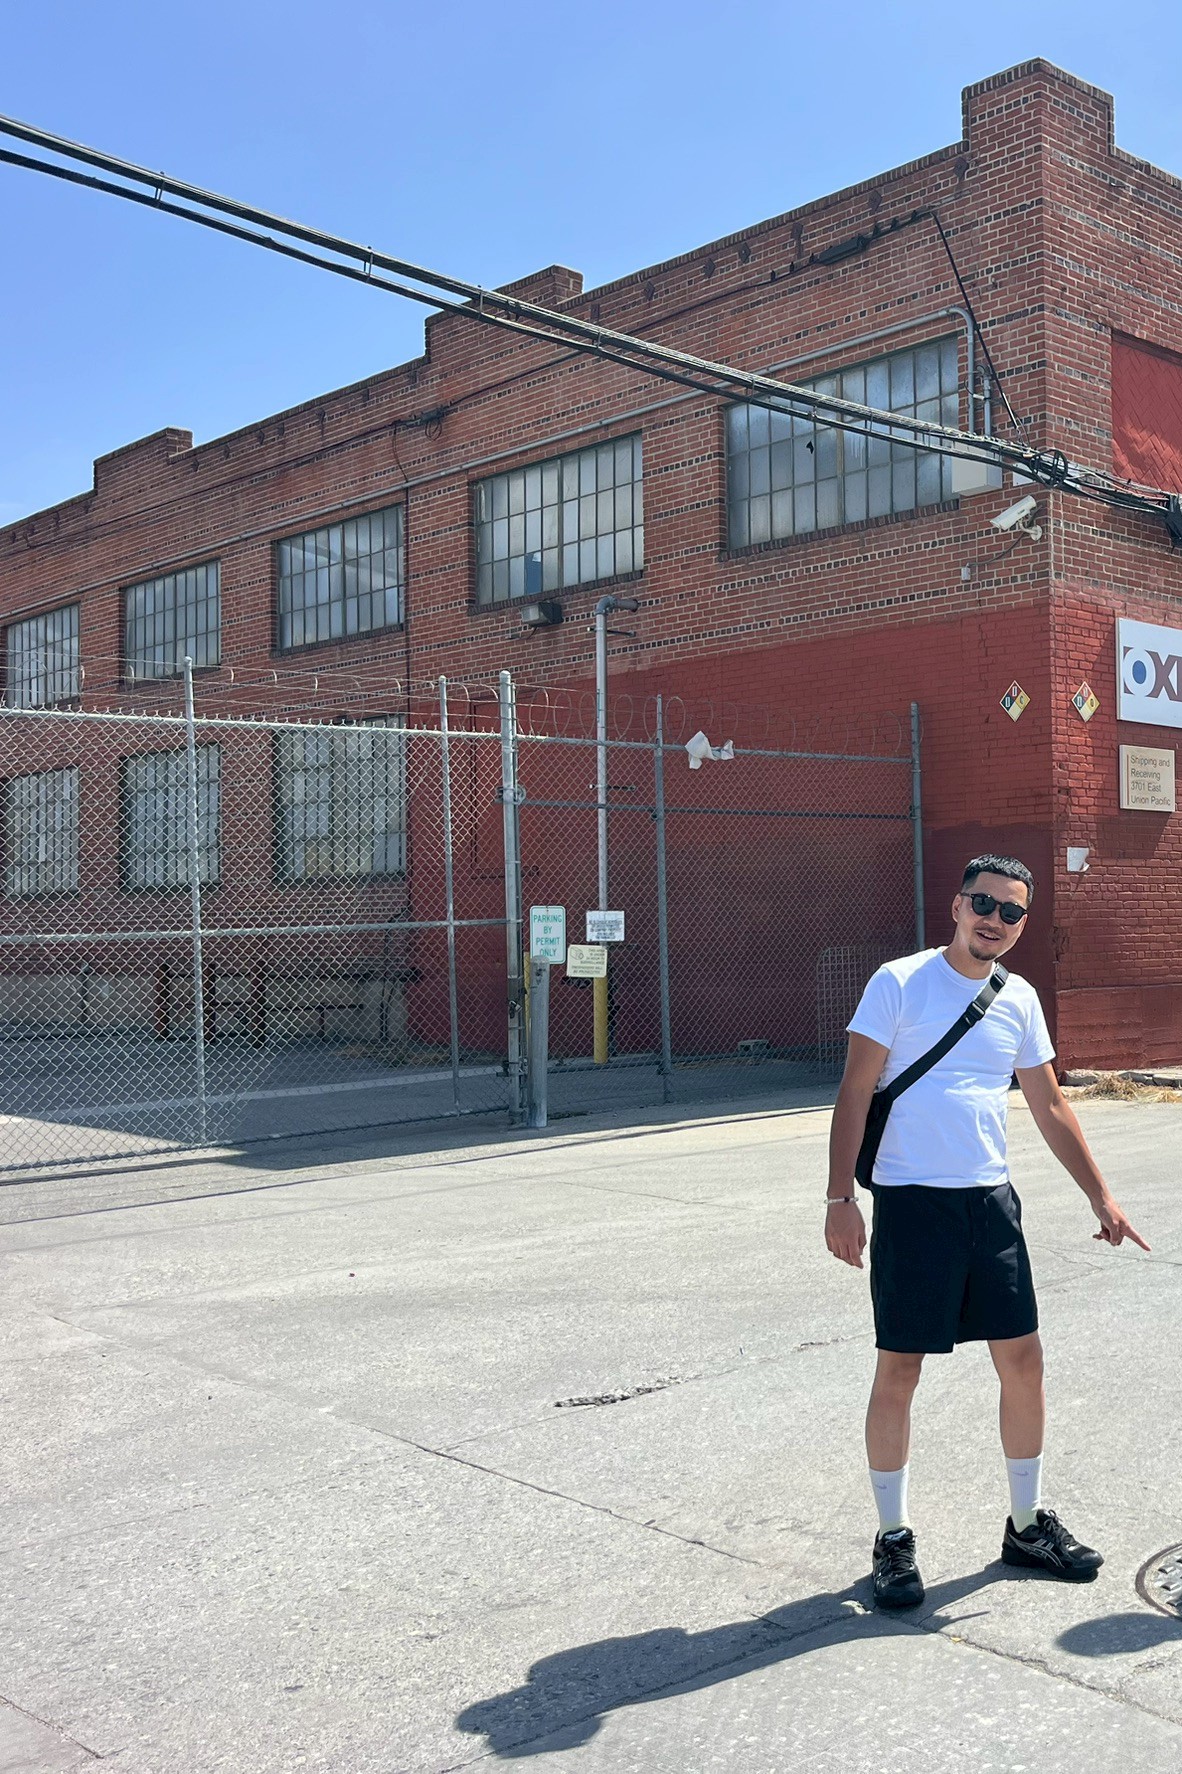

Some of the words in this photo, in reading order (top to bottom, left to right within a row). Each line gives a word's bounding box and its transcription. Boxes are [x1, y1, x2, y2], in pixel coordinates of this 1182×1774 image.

[1130, 754, 1157, 768] Shipping
[1159, 758, 1170, 767] and
[1130, 768, 1160, 781] Receiving
[1131, 781, 1145, 791] 3701
[1148, 782, 1161, 792] East
[1130, 795, 1149, 804] Union
[1150, 796, 1170, 806] Pacific
[533, 914, 562, 923] PARKING
[543, 926, 552, 934] BY
[536, 937, 560, 945] PERMIT
[539, 948, 557, 956] ONLY
